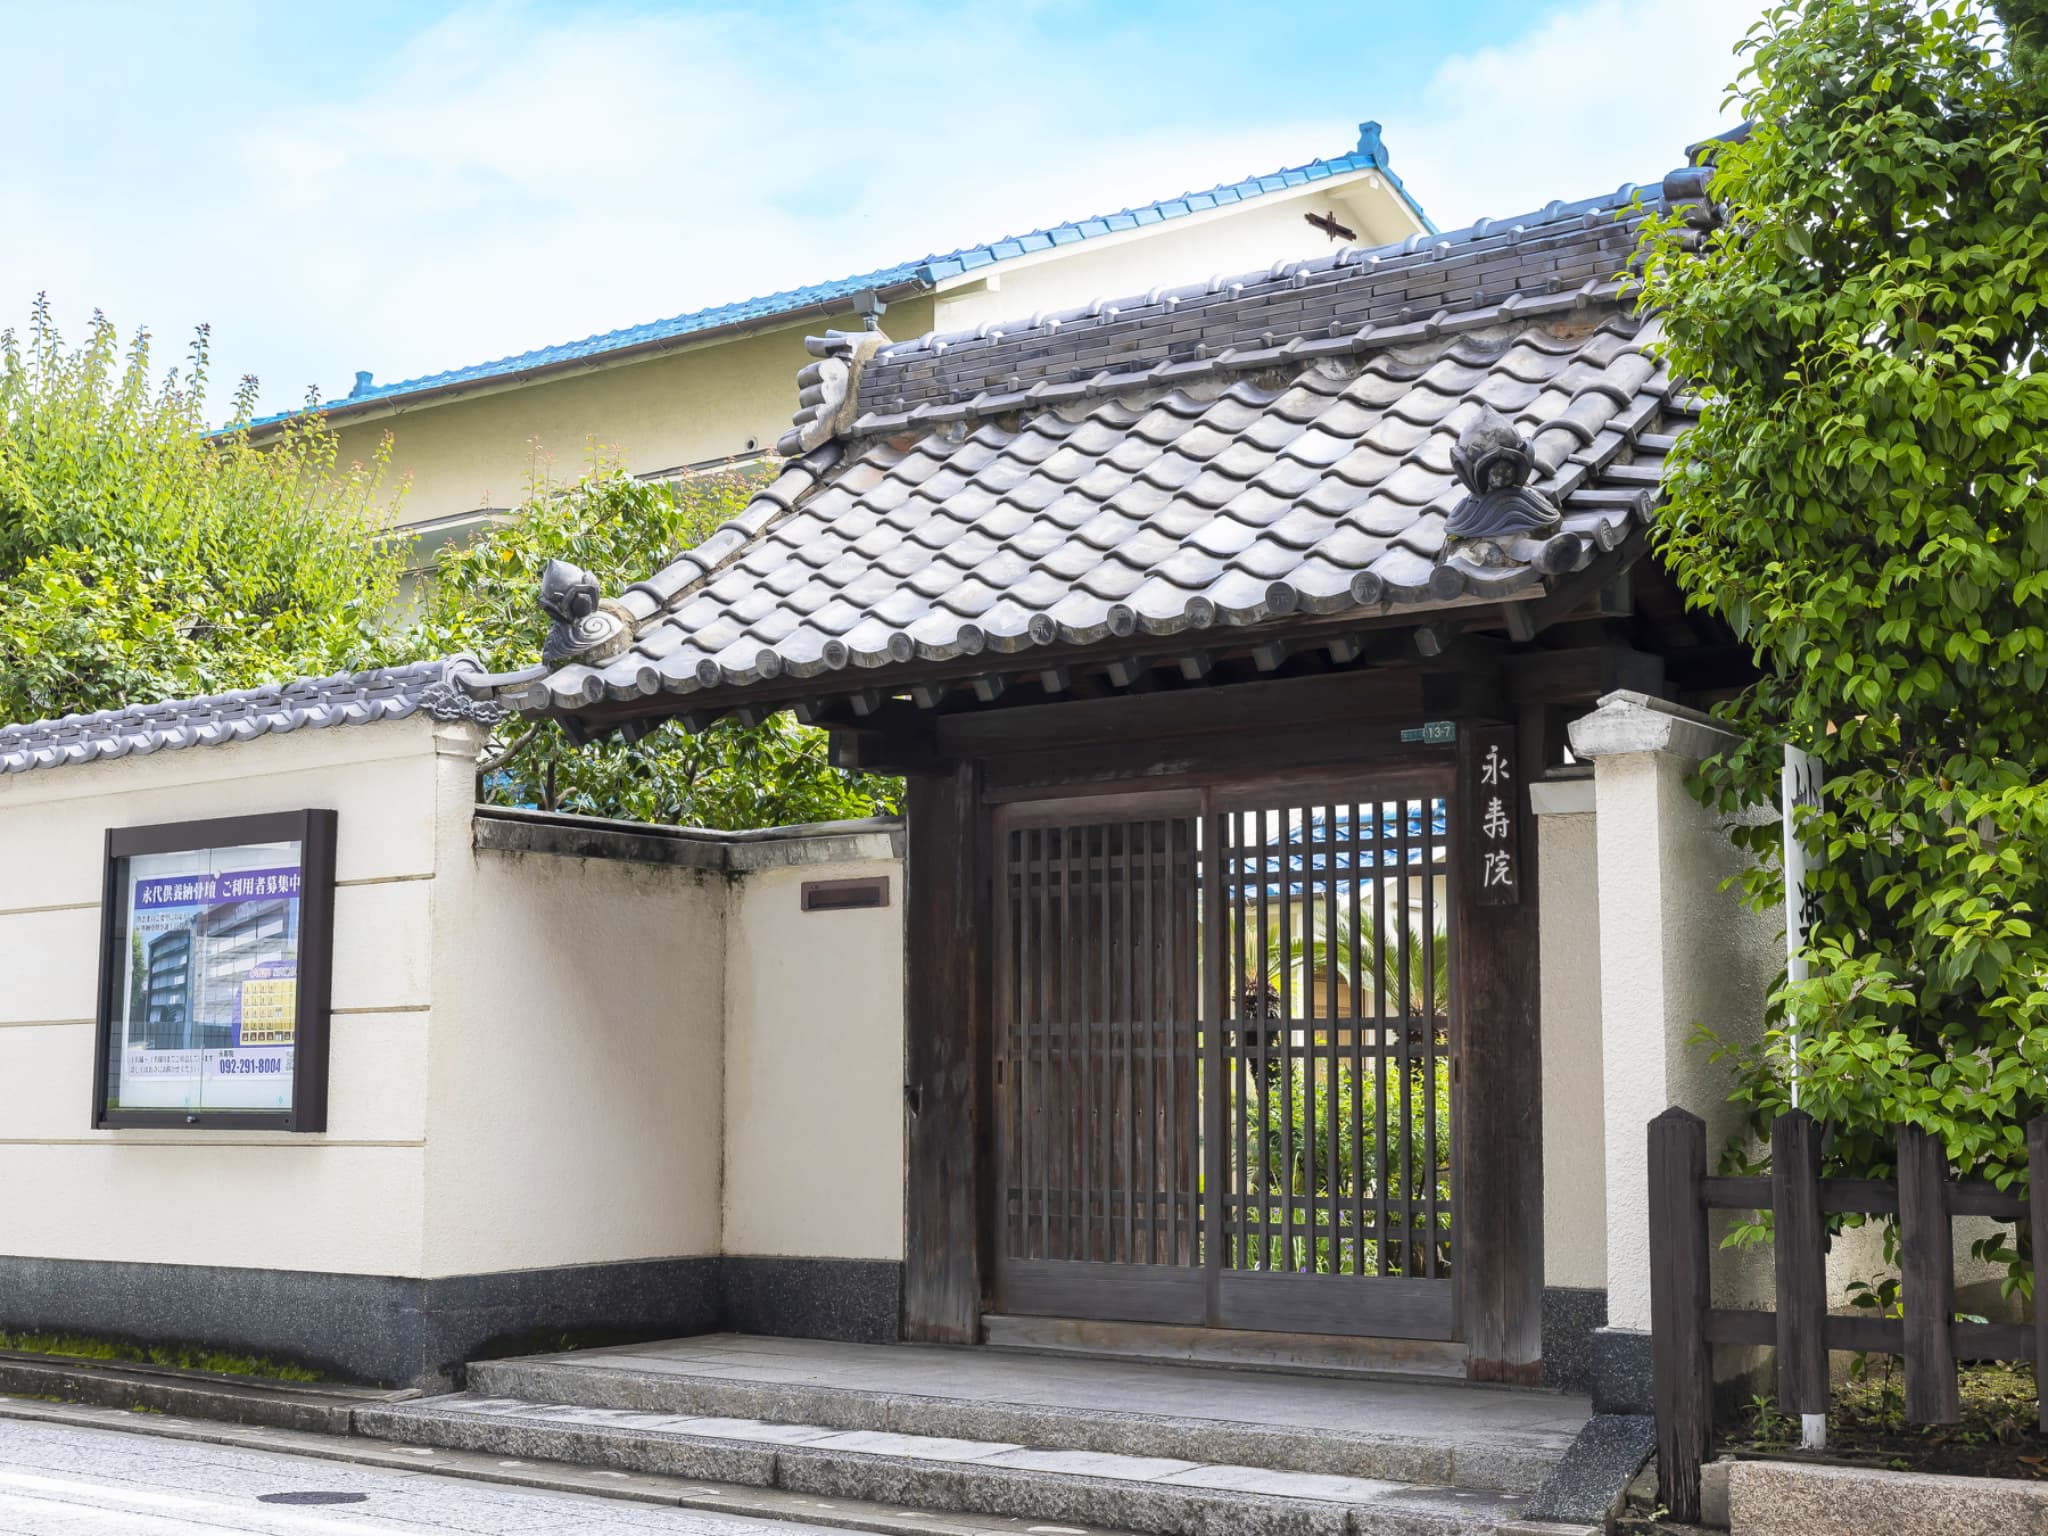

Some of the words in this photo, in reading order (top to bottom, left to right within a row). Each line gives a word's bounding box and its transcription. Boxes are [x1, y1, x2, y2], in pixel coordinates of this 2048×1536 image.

[1428, 726, 1450, 739] 13-7
[1481, 745, 1513, 888] 永寿院
[142, 880, 217, 904] 永代供養納骨壇
[222, 873, 300, 898] ご利用者募集中
